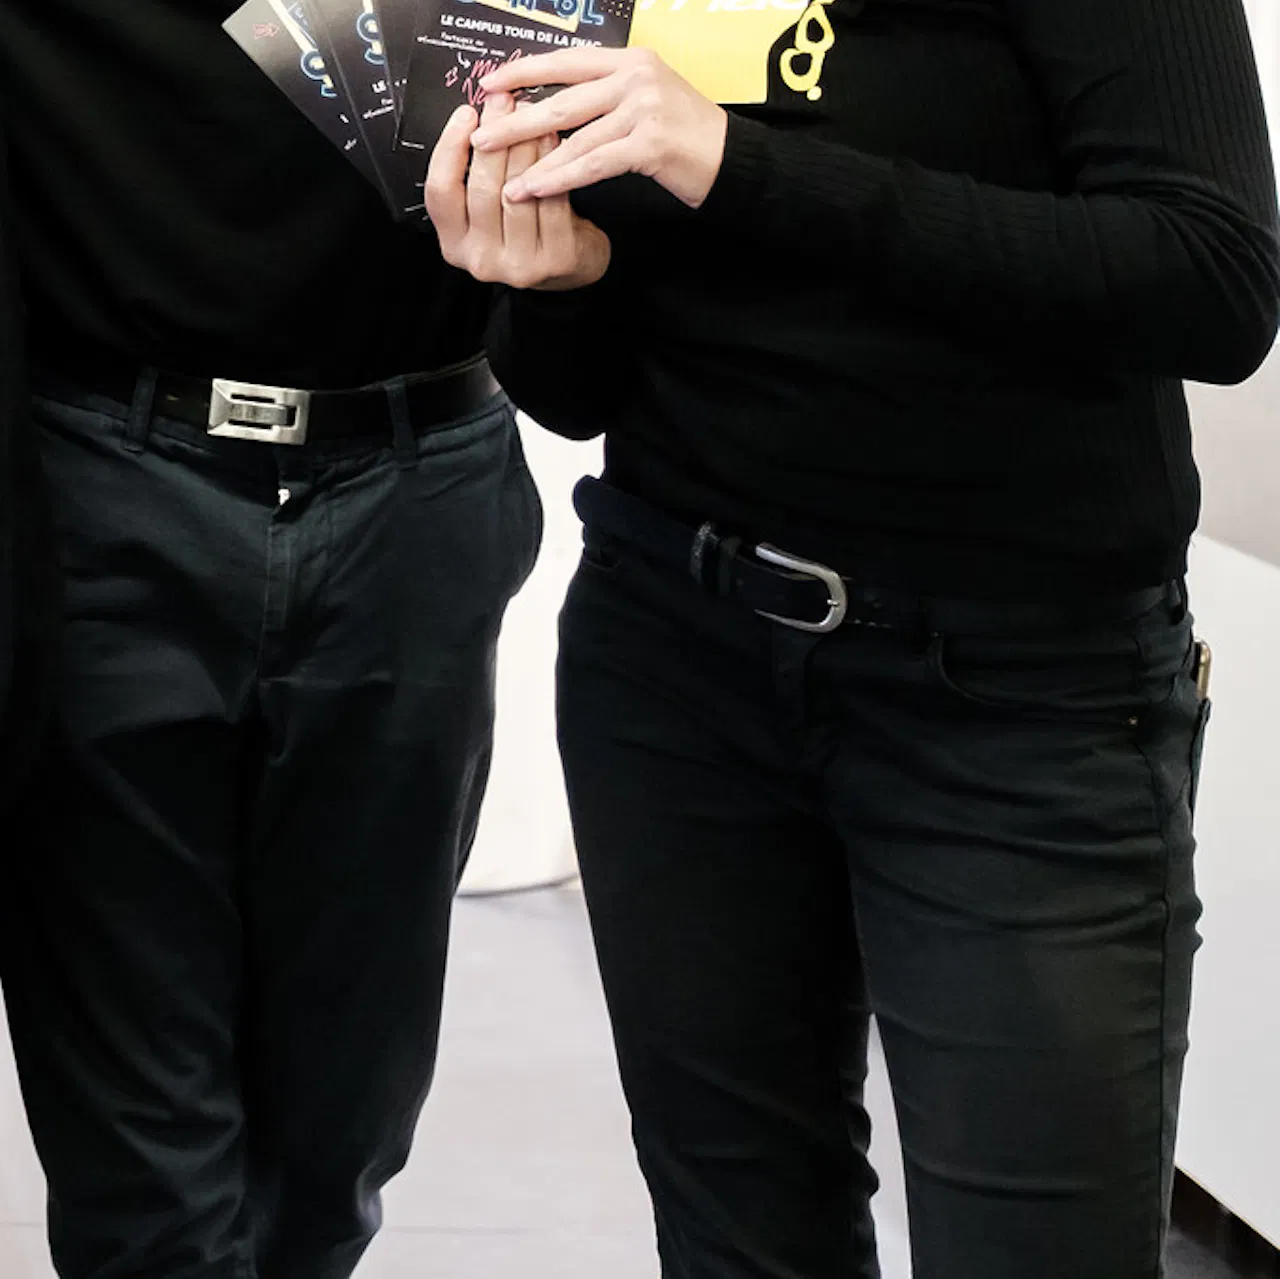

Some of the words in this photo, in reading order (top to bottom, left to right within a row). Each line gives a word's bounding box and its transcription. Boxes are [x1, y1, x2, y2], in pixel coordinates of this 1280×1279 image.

[441, 14, 454, 26] LE
[454, 16, 503, 36] CAMPUS
[505, 25, 535, 41] TOUR
[536, 31, 553, 45] DE
[553, 34, 570, 46] LA
